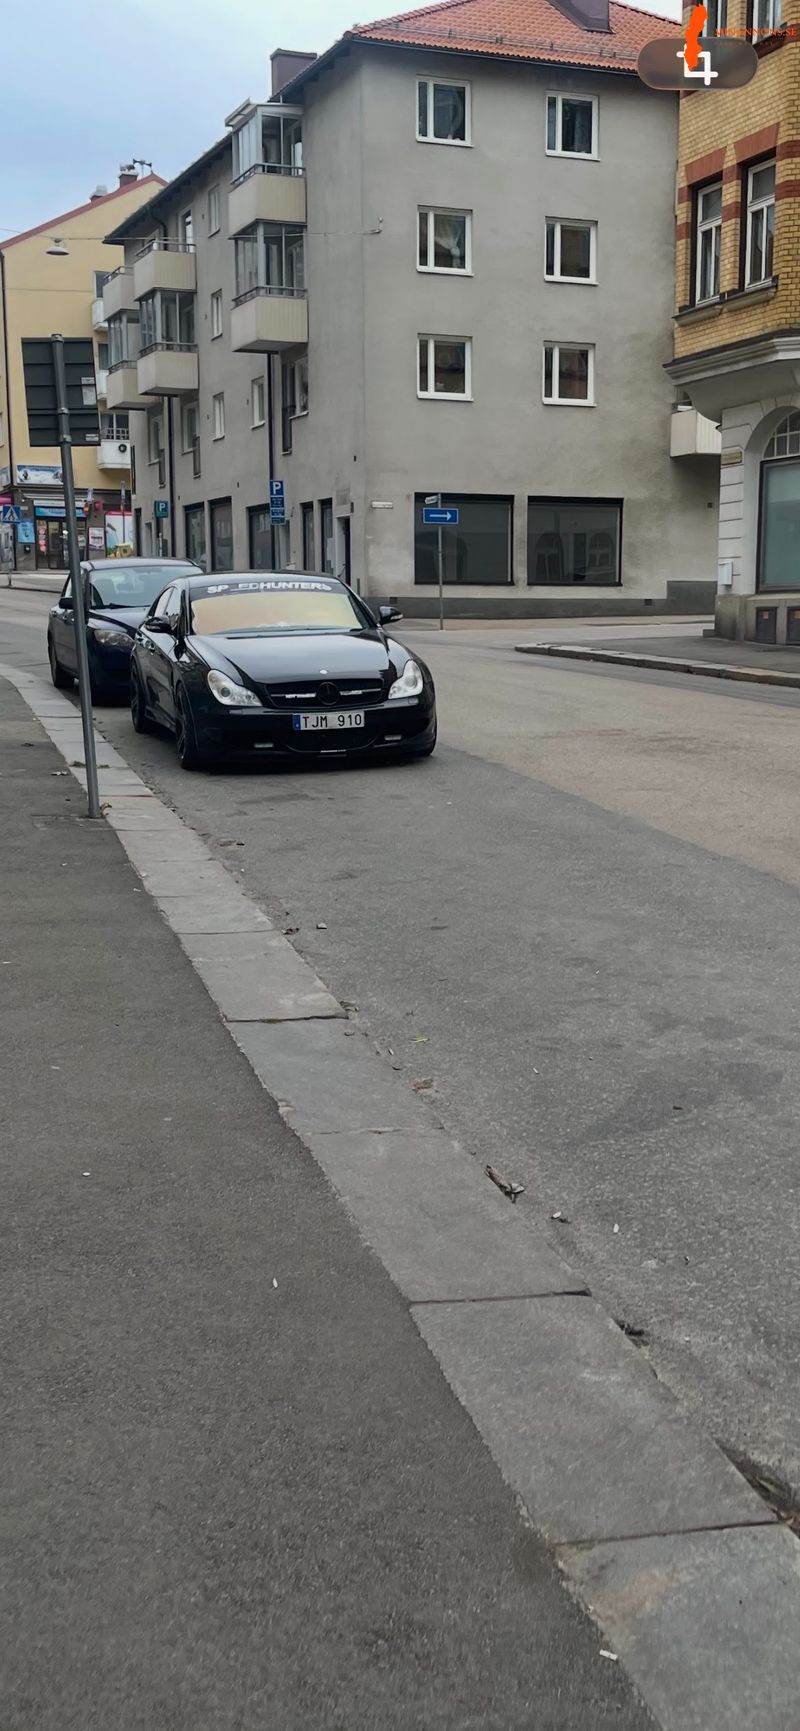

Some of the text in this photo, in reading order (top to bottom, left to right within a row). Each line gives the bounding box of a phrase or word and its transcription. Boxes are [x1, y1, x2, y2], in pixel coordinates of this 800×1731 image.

[273, 482, 282, 495] P
[159, 502, 166, 512] P
[207, 581, 332, 594] SPEDHUNTERS
[302, 713, 362, 728] TJM 910
